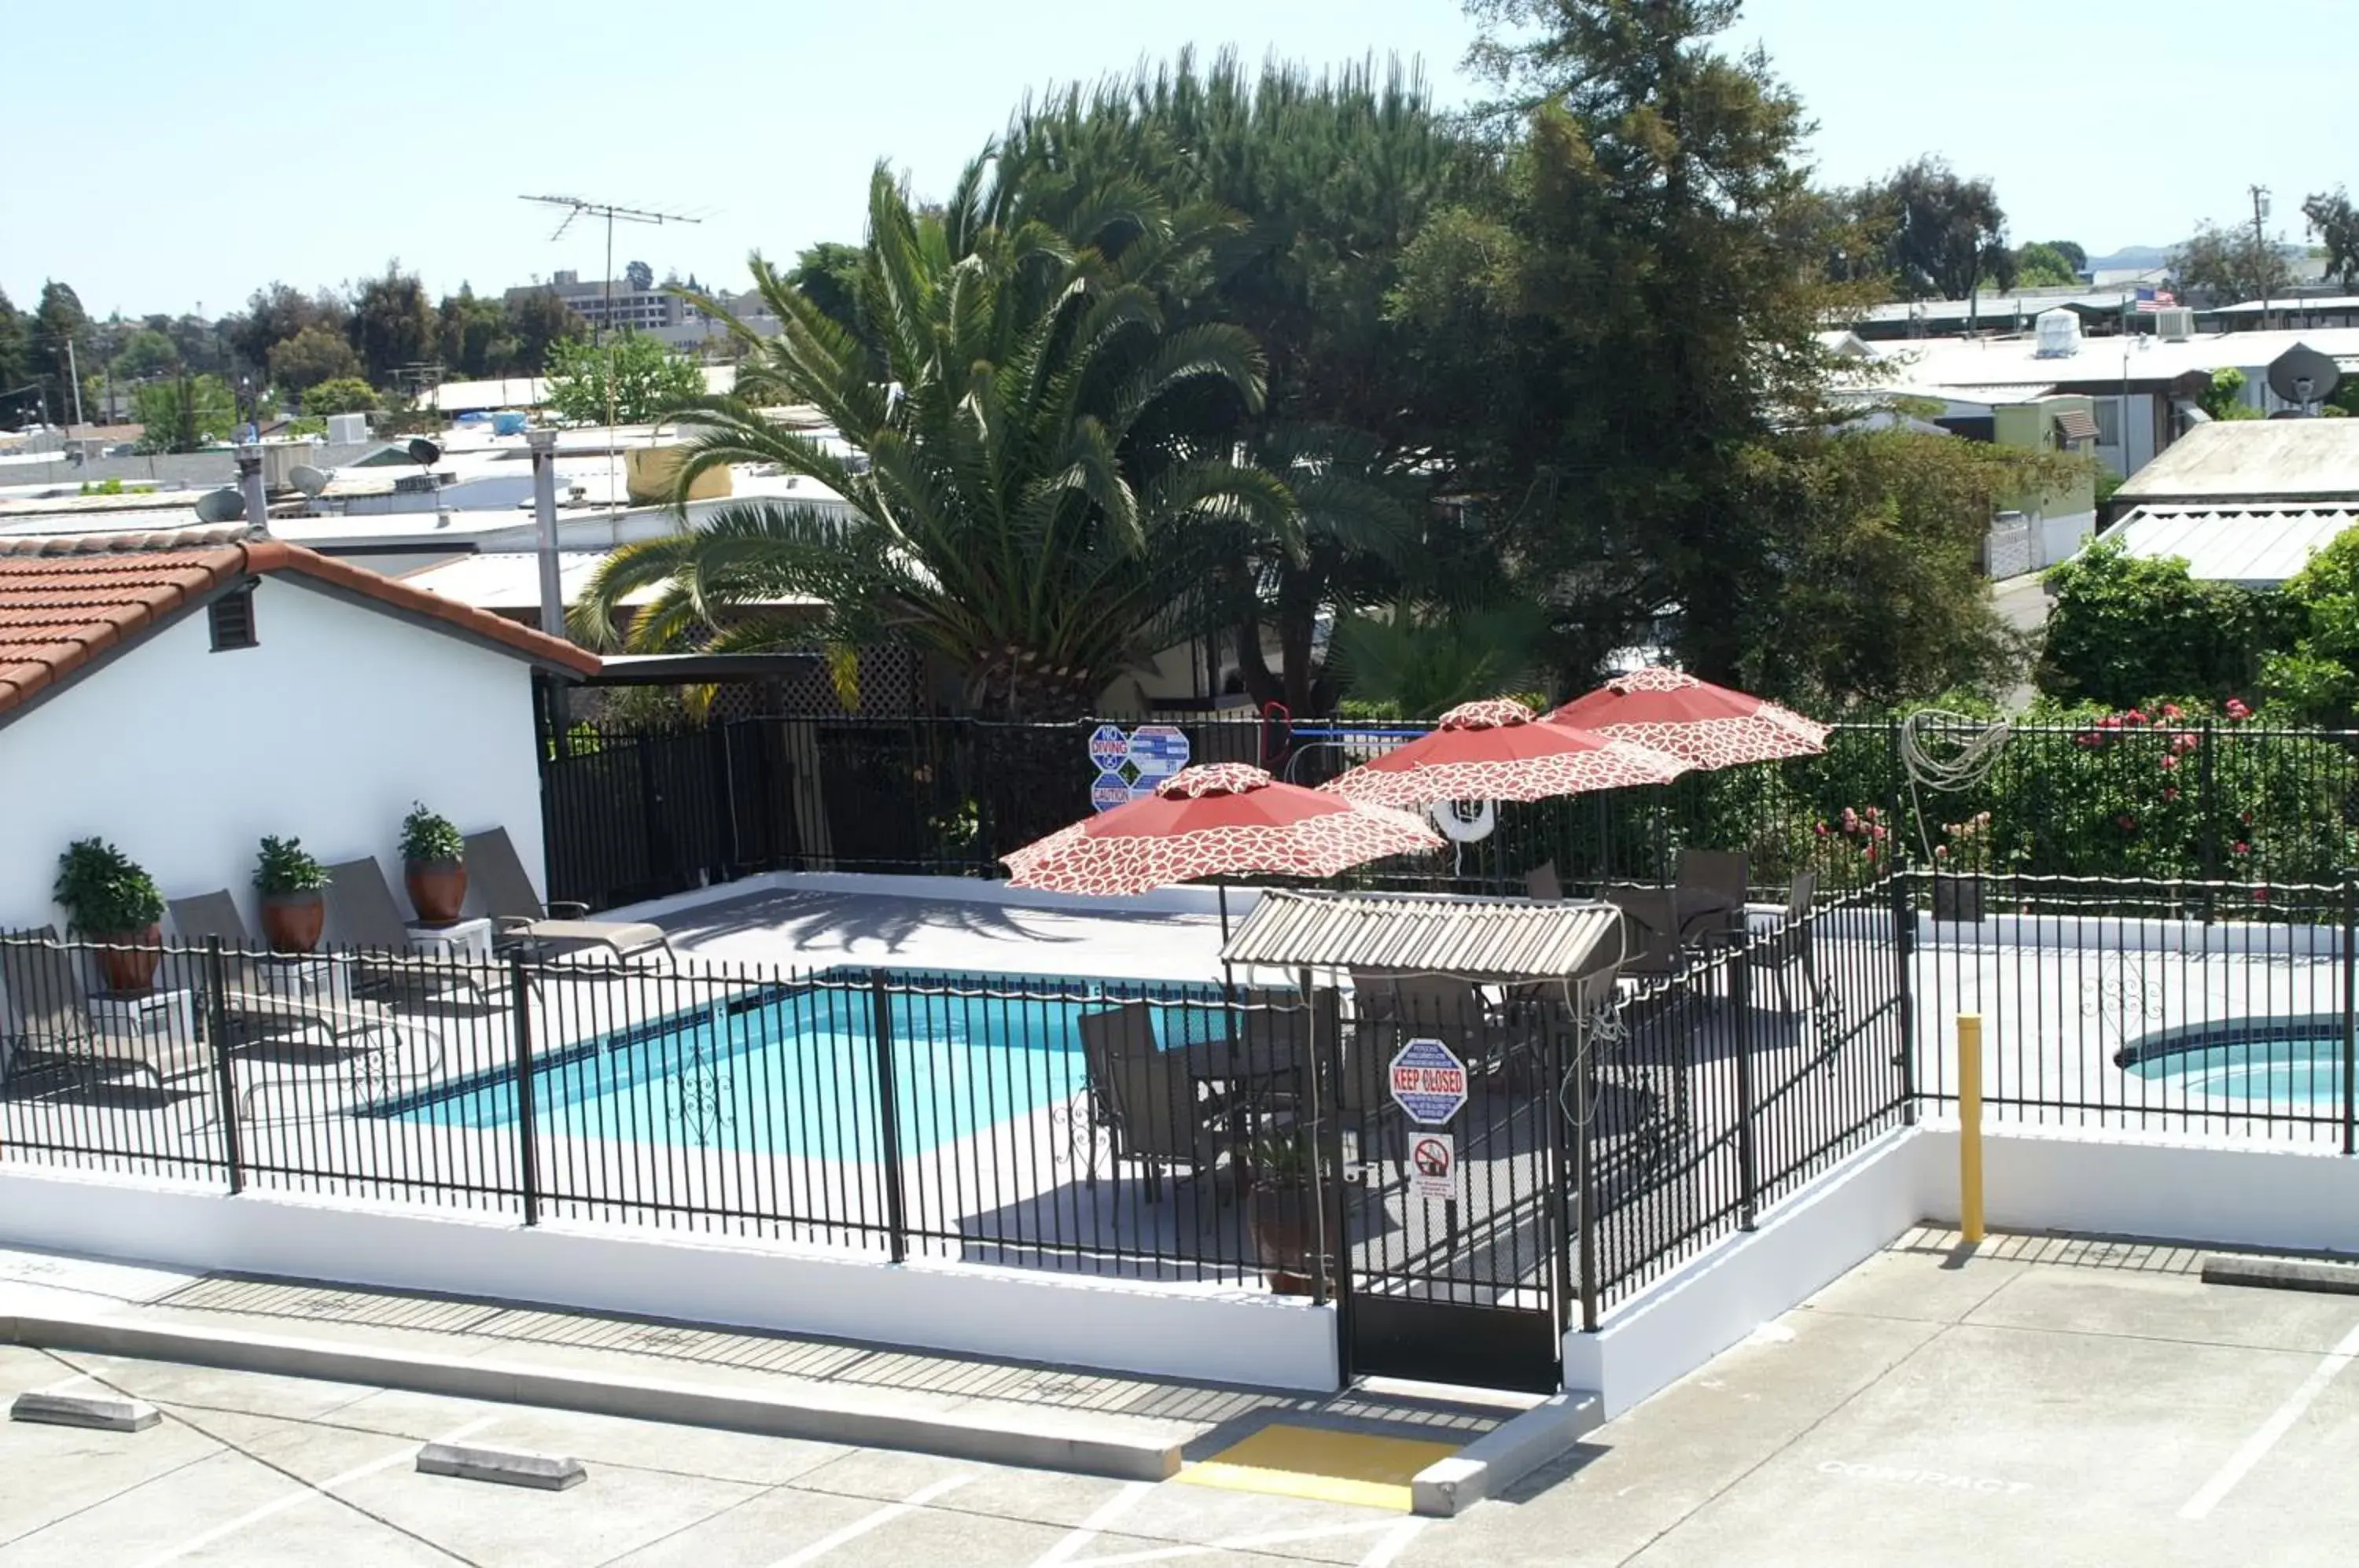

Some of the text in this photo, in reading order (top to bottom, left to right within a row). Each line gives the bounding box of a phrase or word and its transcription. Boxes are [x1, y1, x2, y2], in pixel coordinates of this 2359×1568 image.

[1102, 728, 1117, 740] NO
[1092, 742, 1128, 754] DIVING
[1095, 789, 1128, 802] CAUTION
[1394, 1069, 1462, 1093] KEEP CLOSED
[1816, 1460, 2035, 1493] COMPACT
